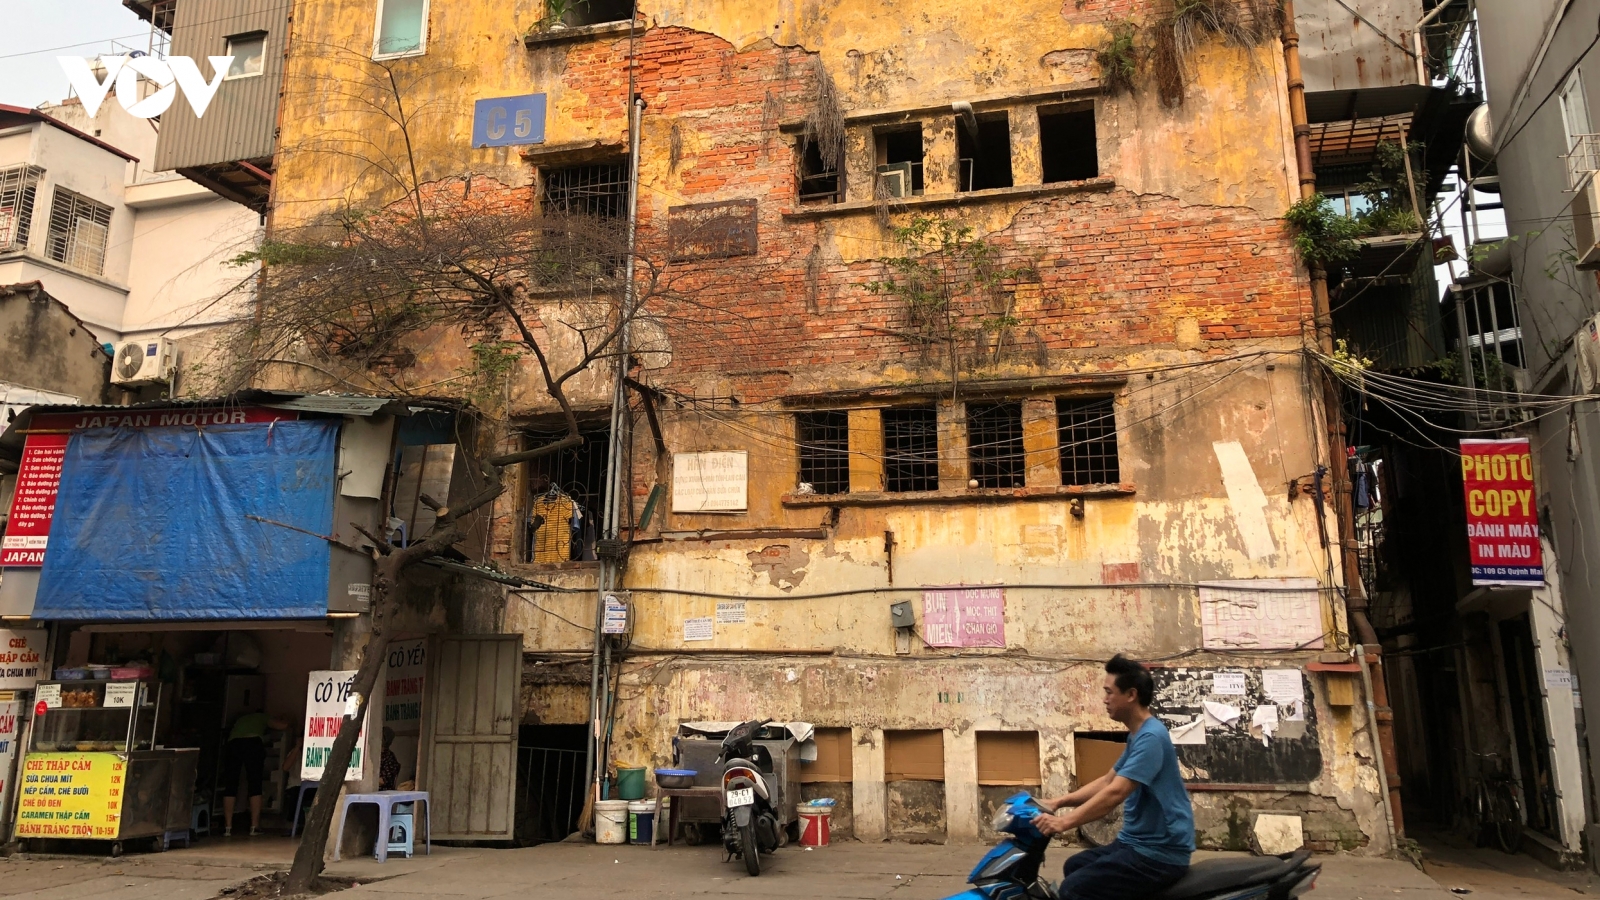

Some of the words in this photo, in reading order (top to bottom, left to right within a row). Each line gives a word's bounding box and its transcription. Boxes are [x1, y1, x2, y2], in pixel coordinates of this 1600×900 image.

[75, 415, 150, 429] JAPAN
[160, 411, 246, 426] MOTOR
[711, 454, 734, 472] ĐIỆN
[1461, 453, 1534, 481] PHOTO
[1469, 489, 1532, 517] COPY
[1508, 521, 1540, 538] MÁY
[4, 551, 45, 562] JAPAN
[1478, 544, 1494, 558] IN
[1498, 542, 1531, 558] MÀU
[1483, 567, 1496, 575] 109
[1497, 567, 1506, 575] C5
[9, 636, 27, 648] CHÈ
[388, 646, 405, 668] CÔ
[6, 668, 24, 678] CHUA
[25, 666, 38, 677] MÍT
[314, 677, 333, 703] CÔ
[336, 674, 357, 703] YẾ
[113, 696, 124, 704] 10K
[308, 713, 325, 737] BÁNH
[305, 743, 322, 767] BÁNH
[26, 758, 44, 771] CHÈ
[46, 757, 70, 773] THẬP
[72, 755, 92, 771] CẨM
[112, 763, 122, 771] 12K
[40, 775, 59, 783] CHUA
[60, 773, 73, 783] MÍT
[111, 776, 121, 784] 12K
[58, 786, 71, 795] CHÈ
[109, 788, 119, 796] 12K
[23, 798, 35, 807] CHÈ
[47, 799, 62, 807] ĐEN
[107, 801, 118, 809] 10K
[21, 811, 54, 820] CARAMEN
[55, 810, 73, 821] THẬP
[106, 814, 117, 822] 15K
[19, 822, 41, 834] BÁNH
[43, 823, 70, 835] TRÁNG
[71, 822, 93, 837] TRỘN
[96, 827, 115, 835] 10-15K
